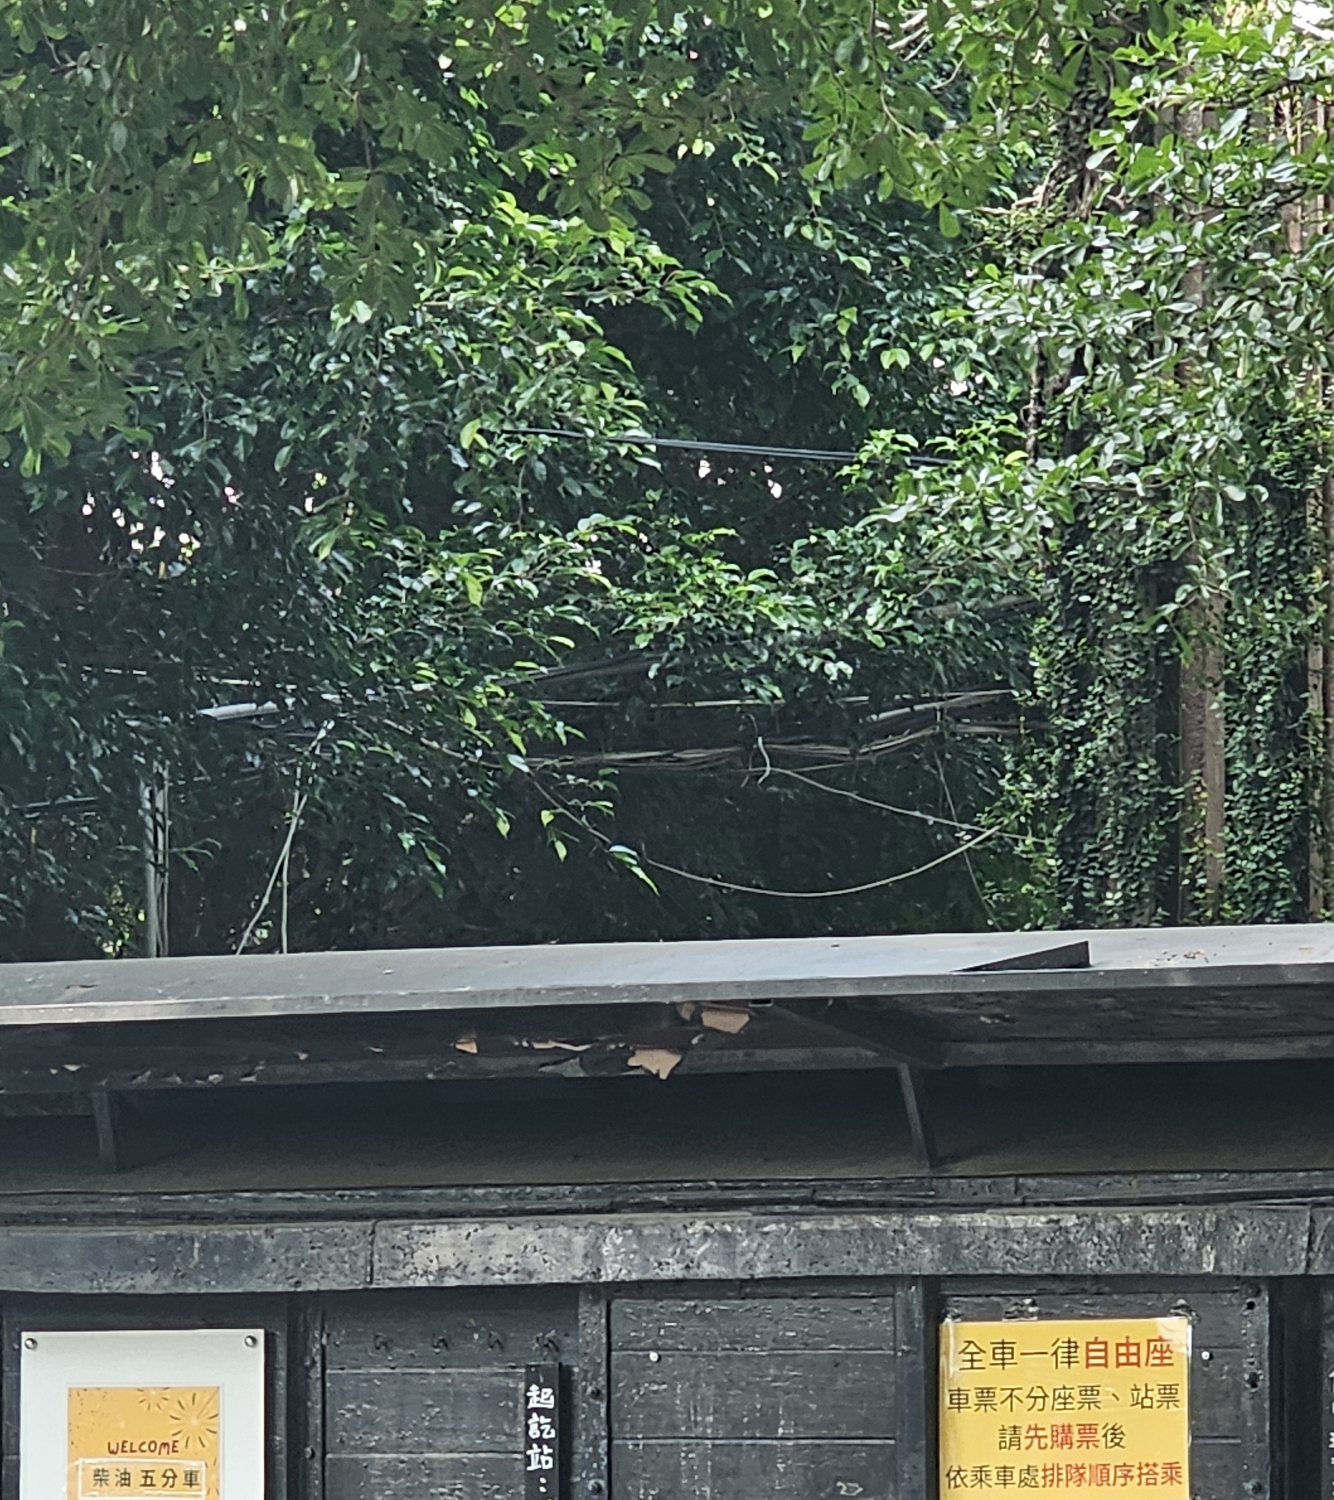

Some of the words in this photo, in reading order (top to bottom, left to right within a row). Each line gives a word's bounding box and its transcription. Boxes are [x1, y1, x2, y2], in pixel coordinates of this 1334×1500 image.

[959, 1335, 1174, 1371] 全車一律自由座
[947, 1383, 1181, 1413] 車票不分座票、站票
[107, 1440, 179, 1455] WELCOME
[998, 1422, 1126, 1451] 請先購票後
[92, 1467, 201, 1489] 柴油五分車
[946, 1461, 1183, 1489] 依乘車處排隊順序搭乘
